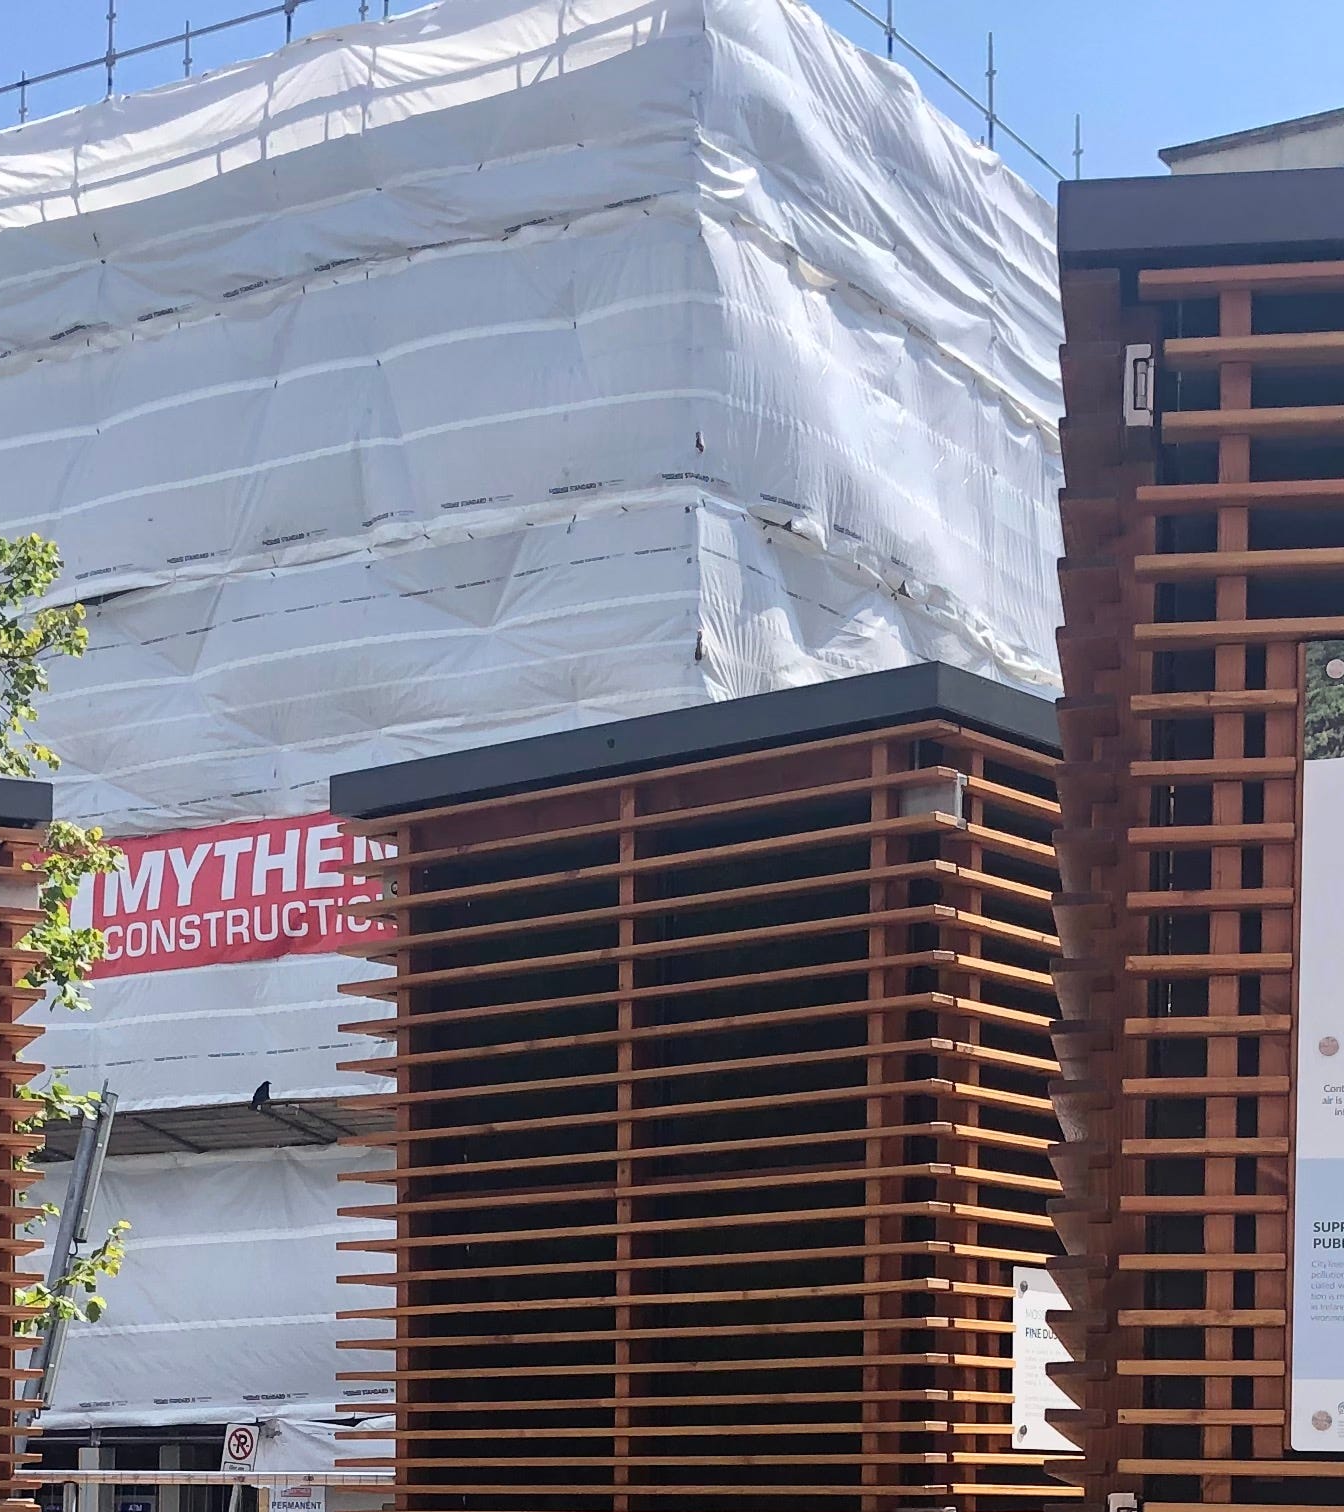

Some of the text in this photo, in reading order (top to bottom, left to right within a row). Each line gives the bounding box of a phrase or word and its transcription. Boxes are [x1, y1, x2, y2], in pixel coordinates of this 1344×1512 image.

[1322, 1096, 1333, 1105] air
[1335, 1096, 1343, 1105] is
[271, 1502, 322, 1510] PERMANENT
